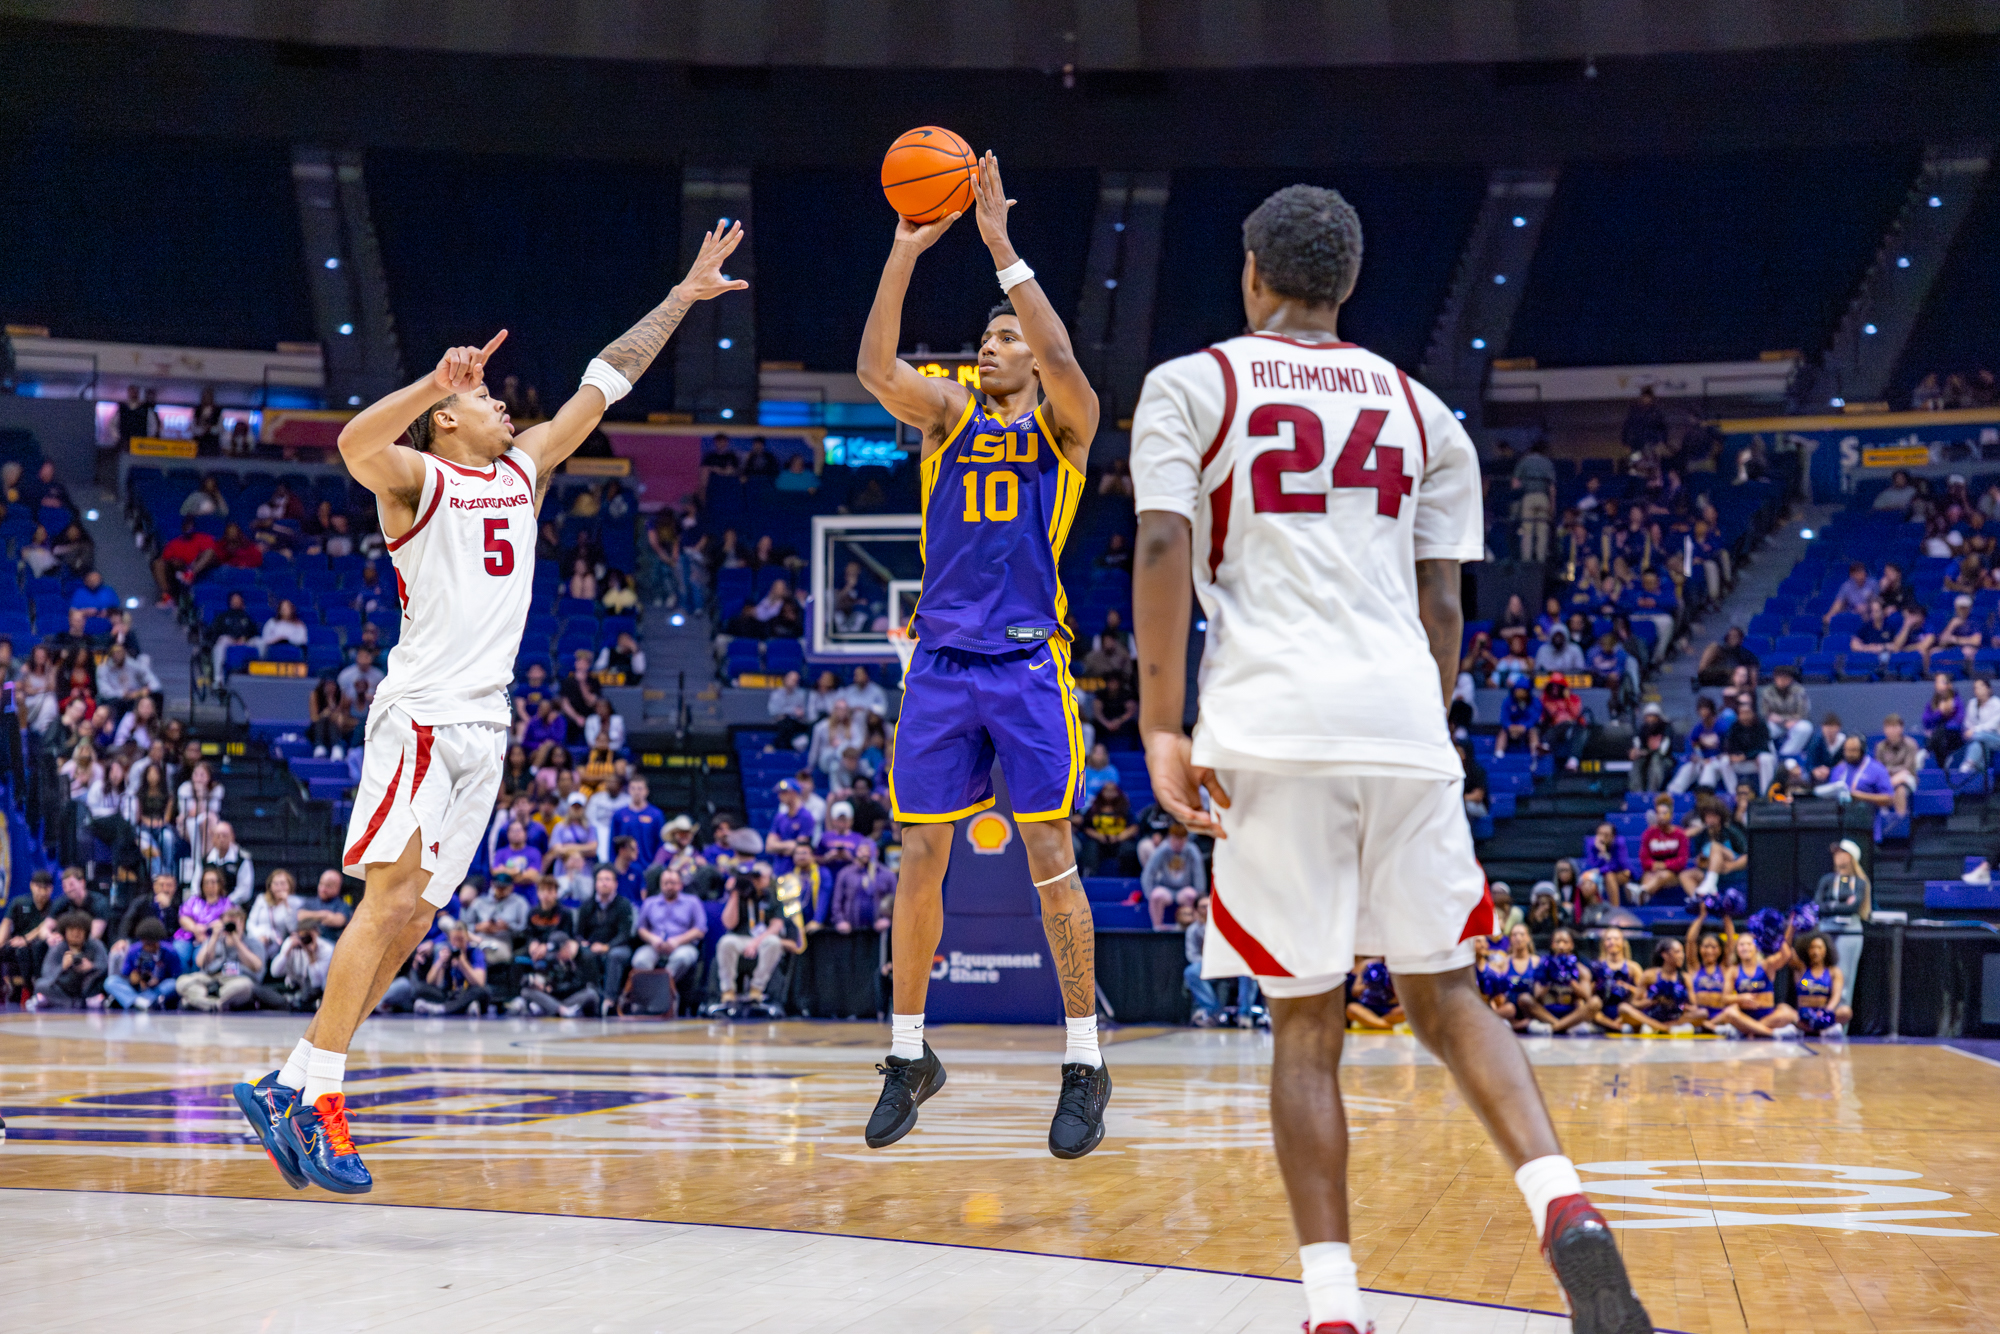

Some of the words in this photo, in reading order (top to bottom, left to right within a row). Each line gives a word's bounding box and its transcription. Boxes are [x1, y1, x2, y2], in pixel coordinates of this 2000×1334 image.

[1251, 360, 1368, 394] RICHMOND
[1370, 371, 1393, 397] III
[1247, 403, 1414, 520] 24
[963, 470, 1019, 522] 10
[483, 517, 515, 576] 5
[949, 951, 1042, 969] Equipment
[949, 967, 1000, 983] Share
